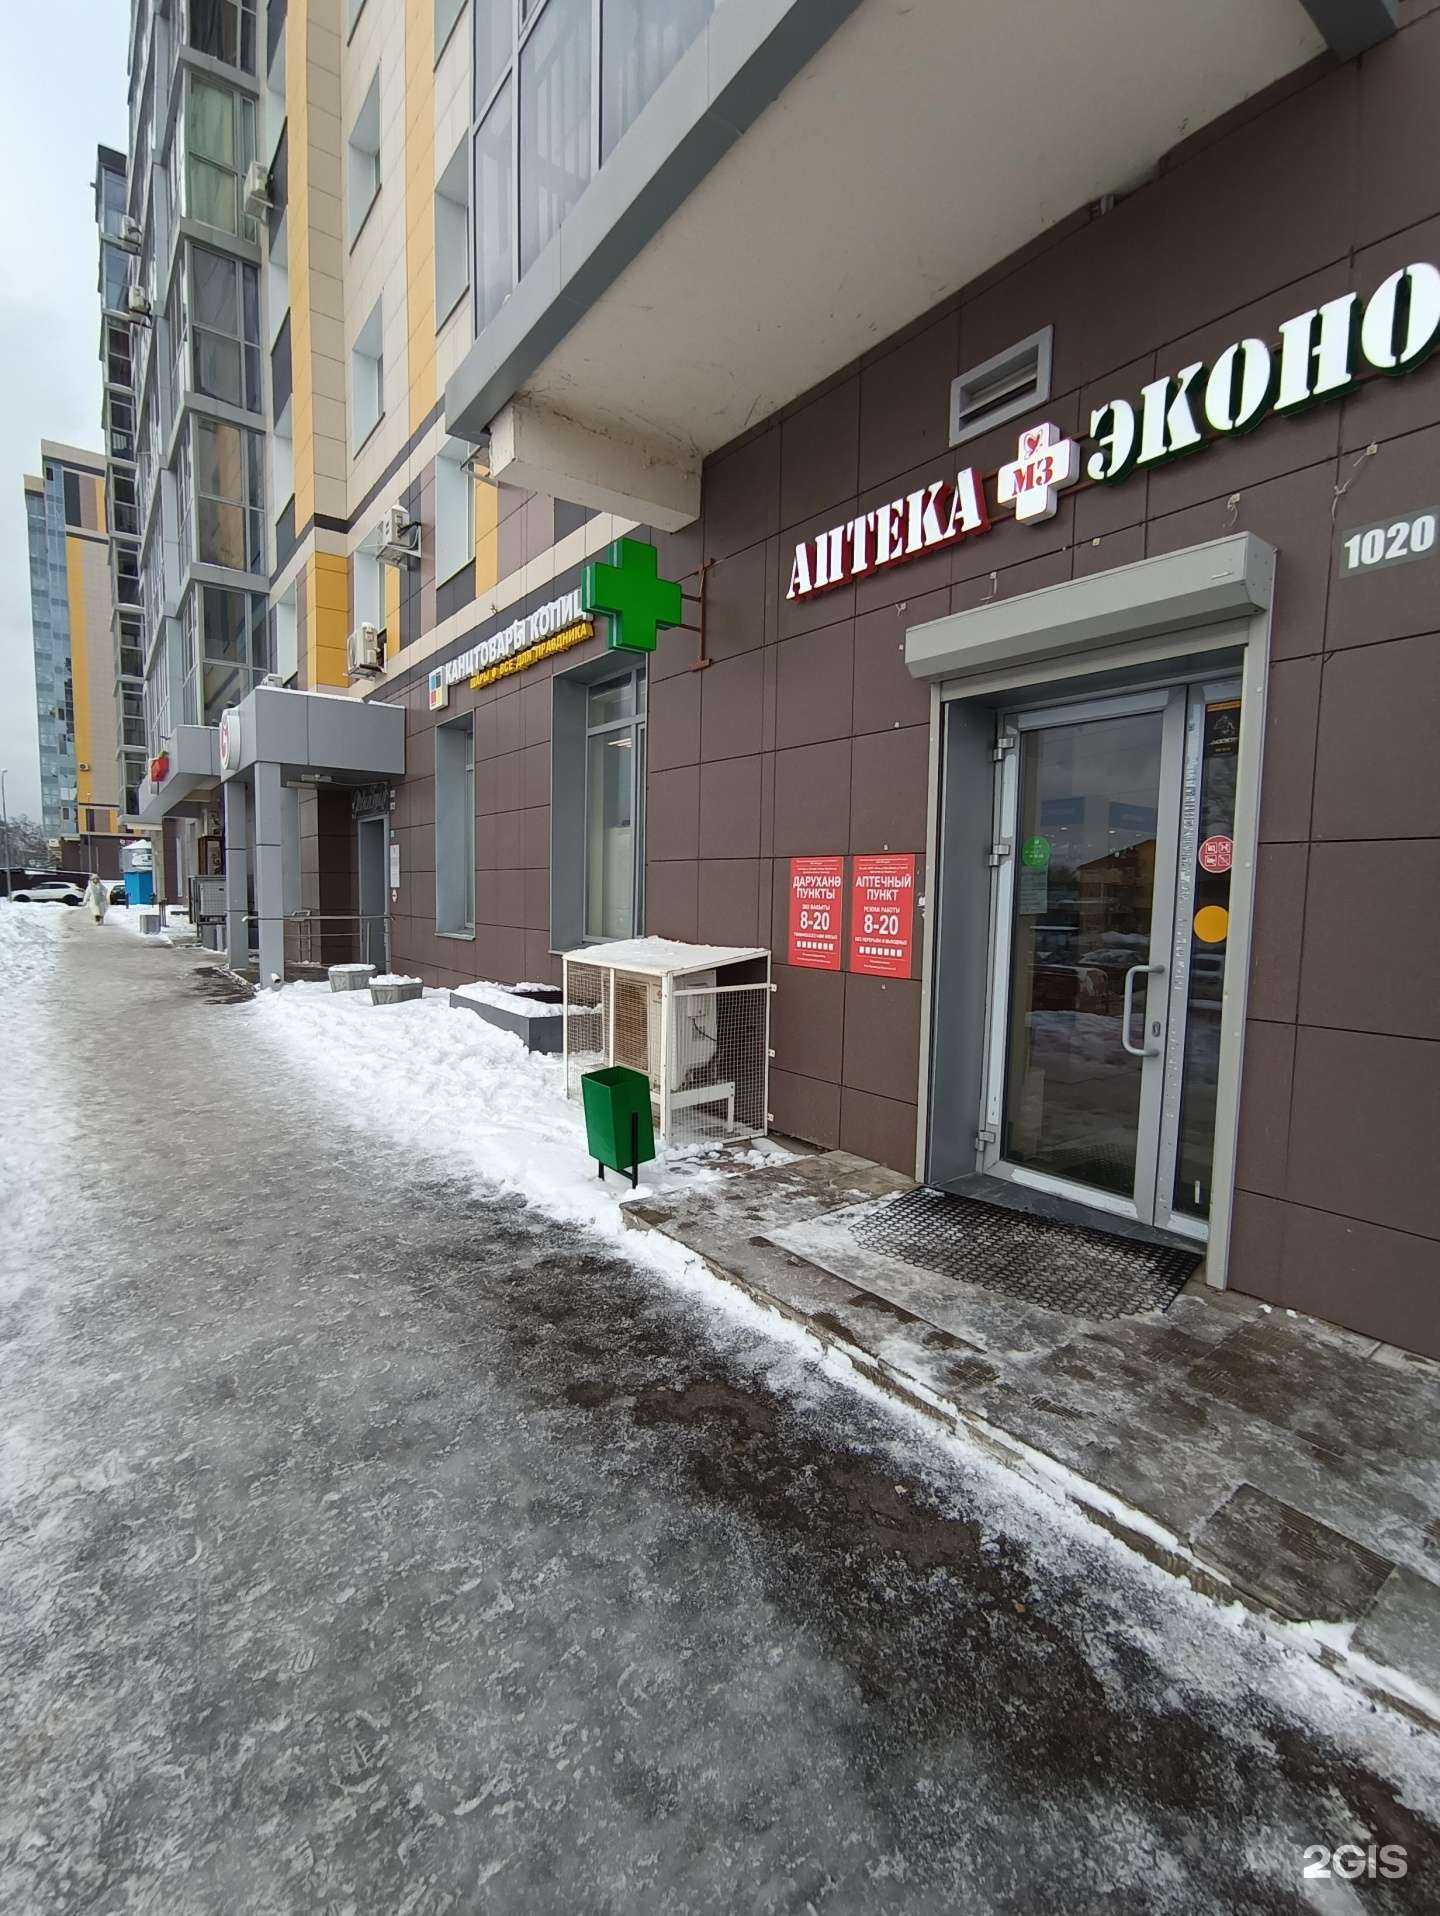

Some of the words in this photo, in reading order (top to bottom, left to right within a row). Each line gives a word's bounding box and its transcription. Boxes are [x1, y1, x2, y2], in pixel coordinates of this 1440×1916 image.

[785, 467, 984, 601] АПТЕКА
[1086, 262, 1440, 482] ЭКОНО
[1344, 515, 1435, 569] 1020
[446, 619, 526, 685] КАНЦТОВАРЫ
[856, 874, 912, 888] АПТЕЧНЫЙ
[796, 888, 836, 900] ПУНКТЫ
[867, 889, 899, 901] ПУНКТ
[800, 911, 830, 931] 8-20
[864, 914, 899, 935] 8-20
